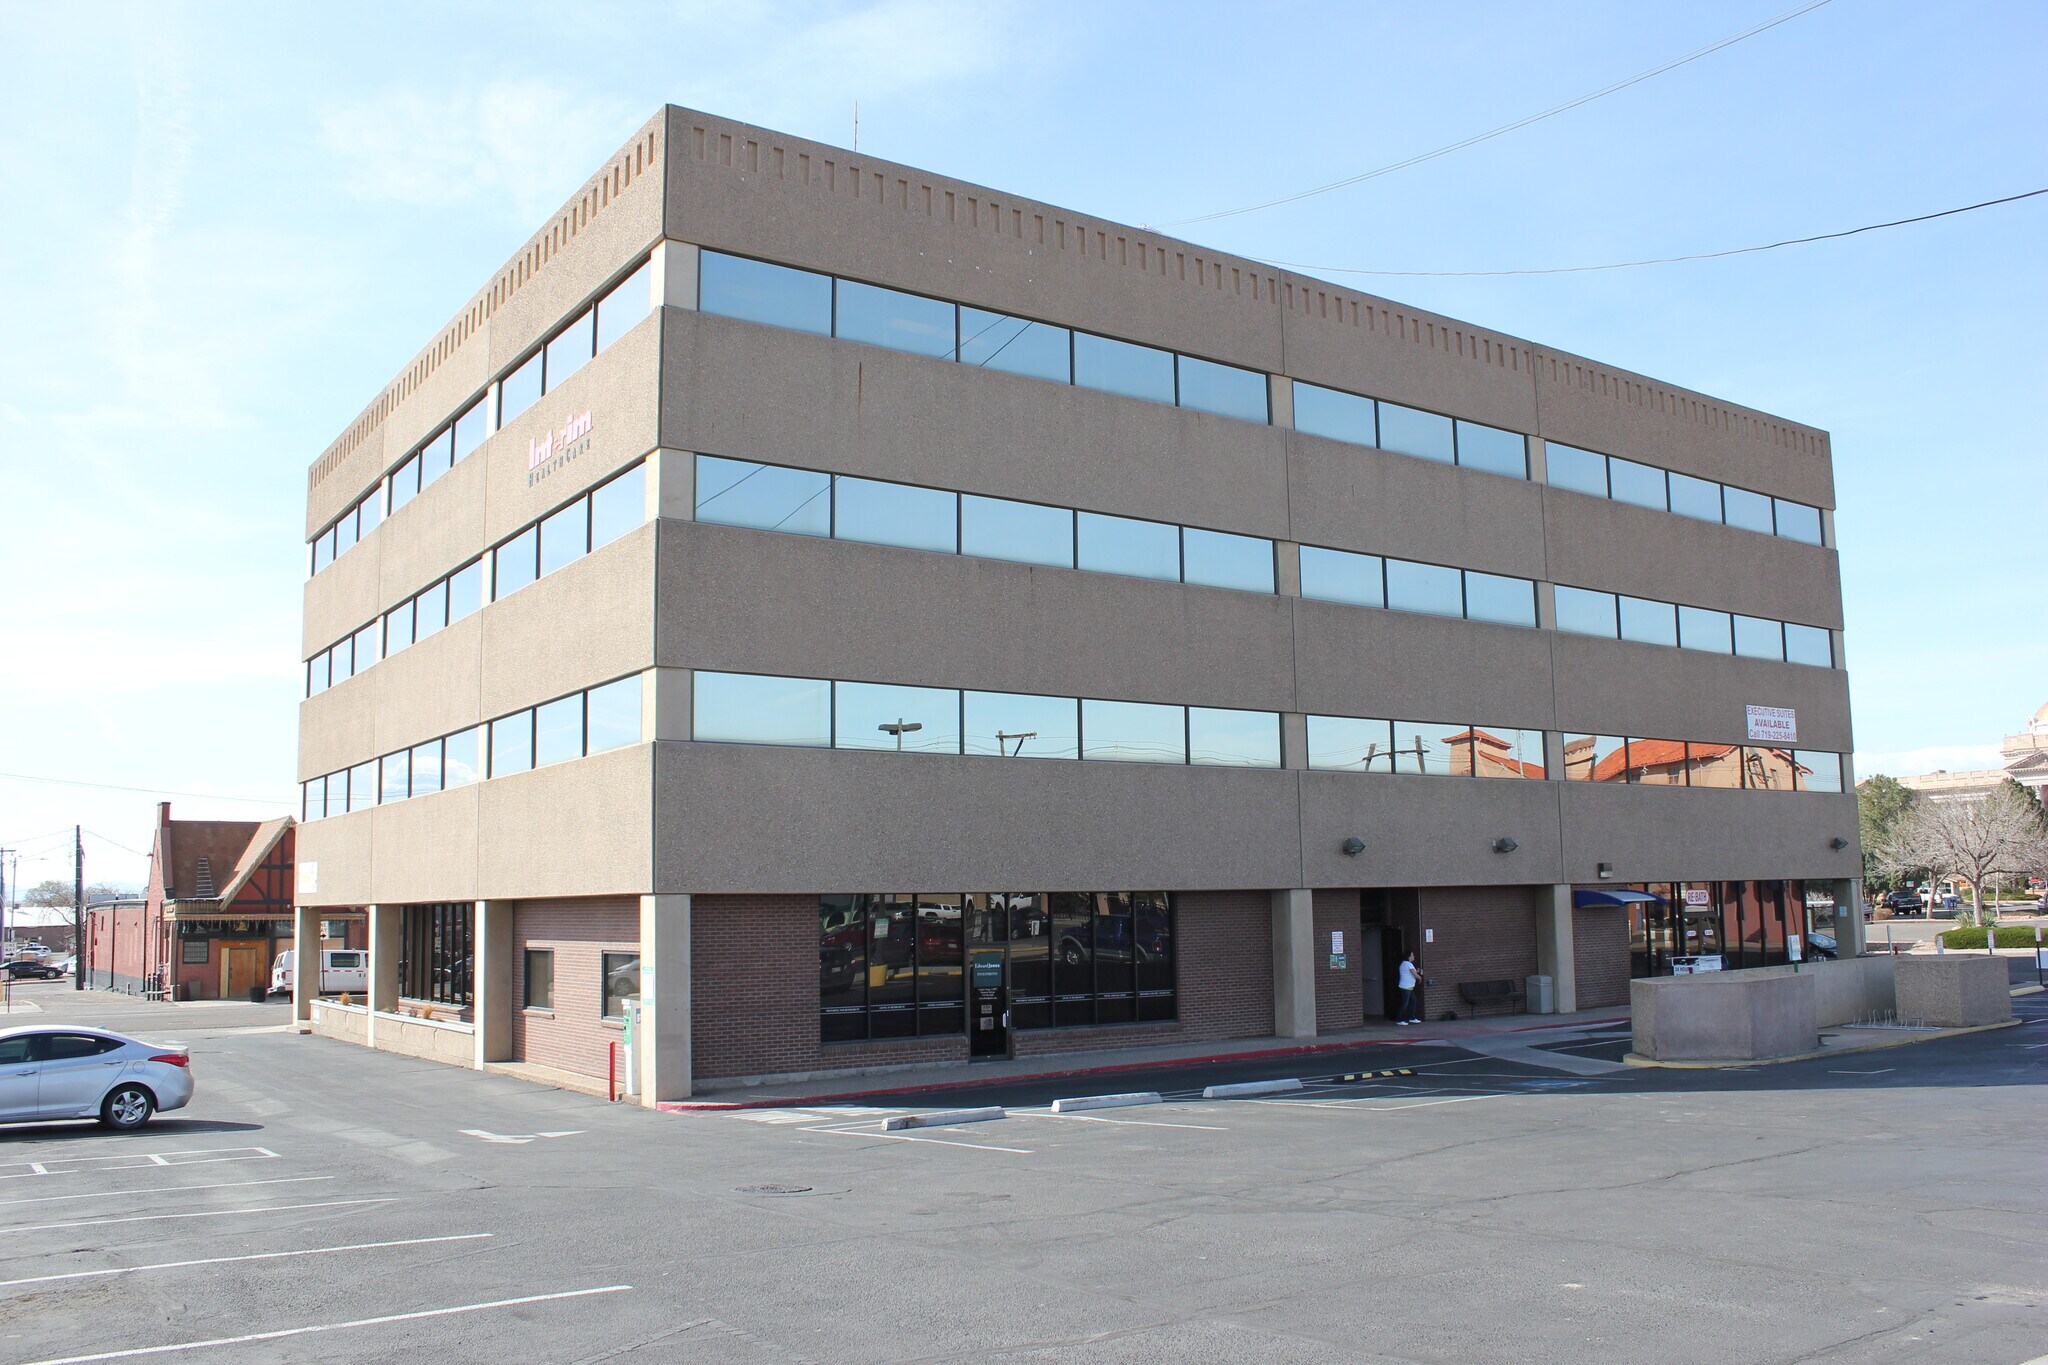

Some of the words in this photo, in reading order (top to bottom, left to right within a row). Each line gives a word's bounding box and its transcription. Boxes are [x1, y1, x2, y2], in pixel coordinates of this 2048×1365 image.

[1747, 706, 1776, 717] EXECUTIVE
[1777, 710, 1794, 718] SUITES
[1754, 719, 1790, 729] AVAILABLE
[1750, 729, 1760, 738] Call
